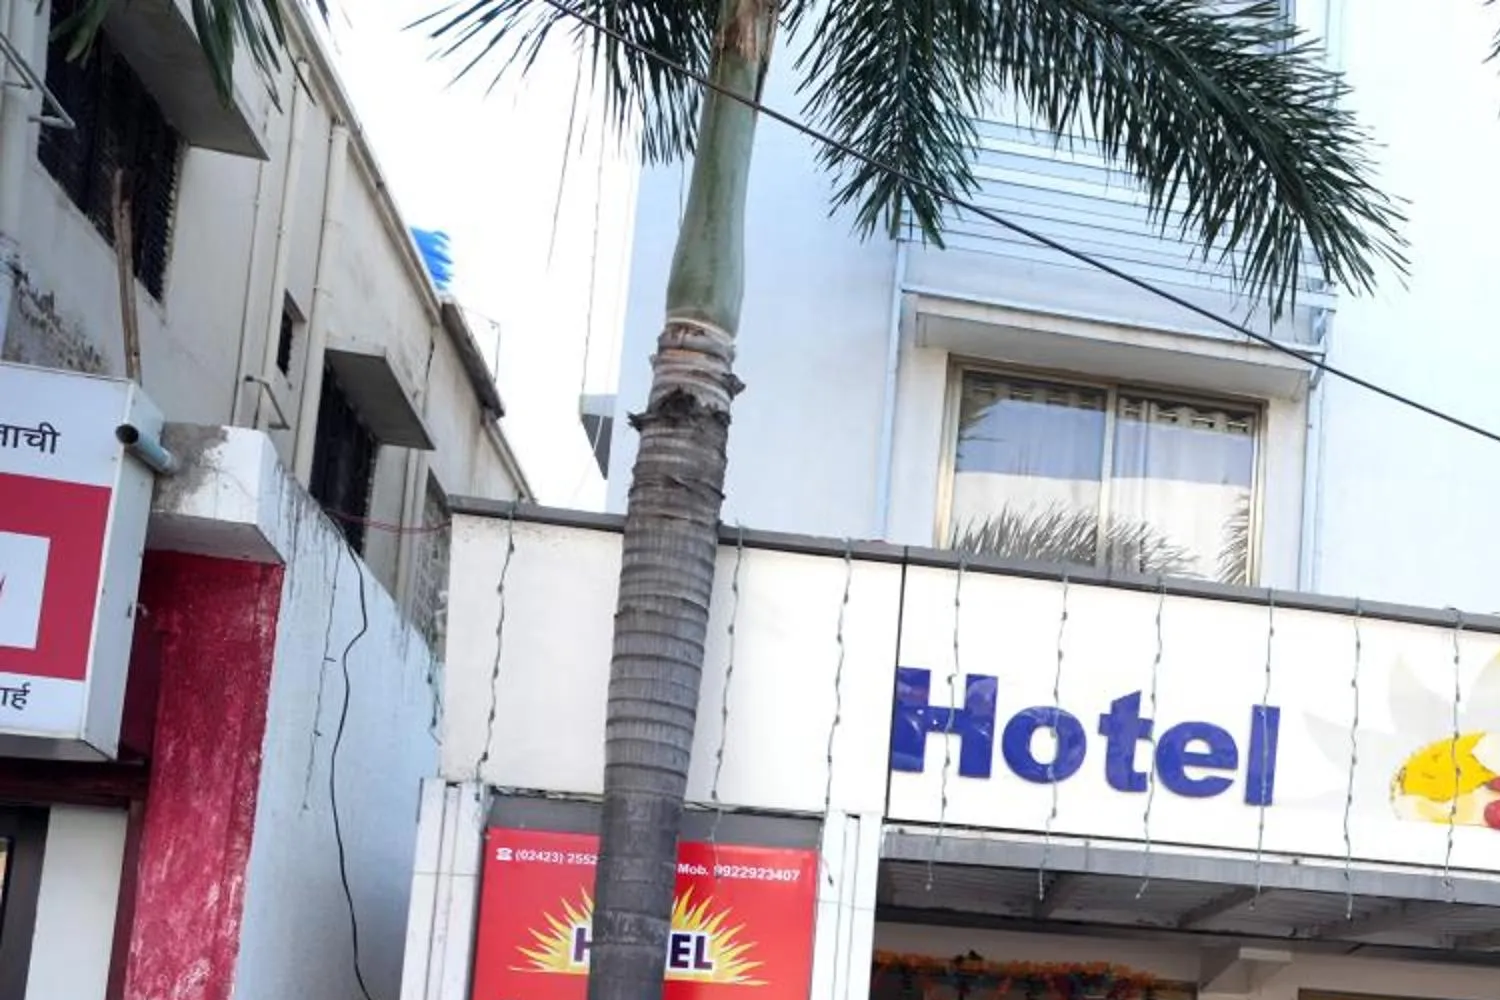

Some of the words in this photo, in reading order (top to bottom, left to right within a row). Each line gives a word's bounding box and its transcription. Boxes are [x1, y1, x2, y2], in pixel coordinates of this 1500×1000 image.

[891, 666, 1281, 807] Hotel
[567, 852, 598, 865] 2552
[677, 863, 709, 876] Mob.
[573, 926, 713, 970] HEL
